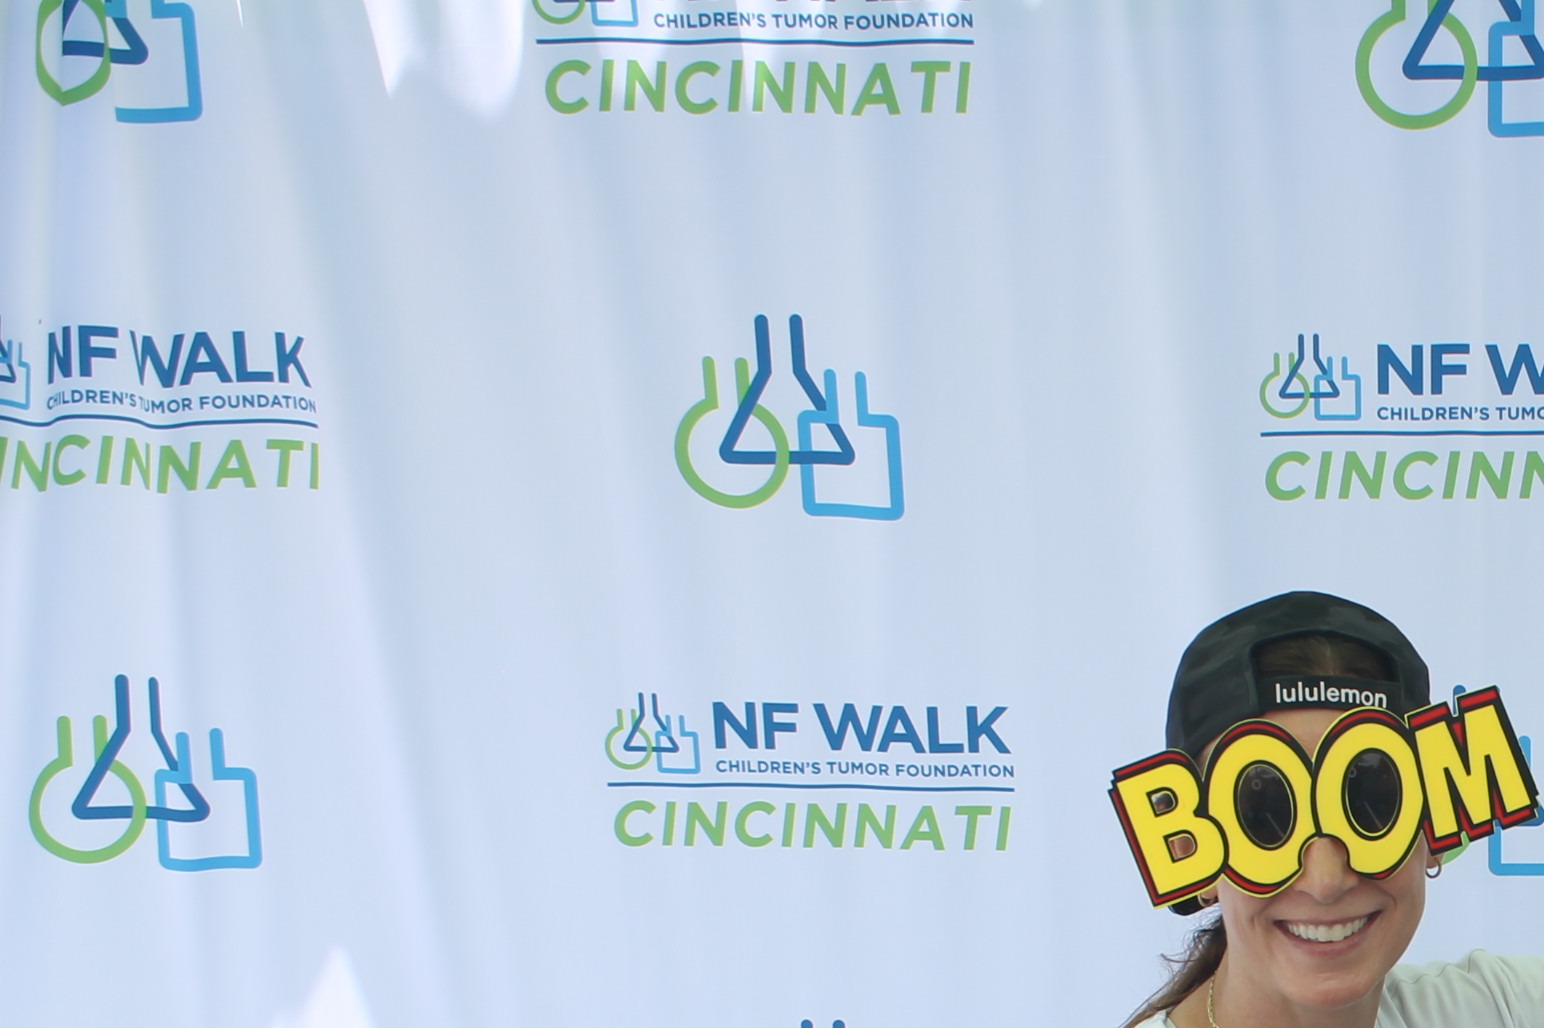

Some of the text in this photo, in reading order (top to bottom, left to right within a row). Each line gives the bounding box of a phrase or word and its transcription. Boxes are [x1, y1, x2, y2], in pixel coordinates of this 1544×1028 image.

[654, 12, 973, 29] CHILDREN'S TUMOR FOUNDATION
[545, 59, 970, 115] CINCINNATI
[48, 325, 310, 388] NF WALK
[1377, 343, 1470, 395] NF
[47, 389, 315, 413] CHILDREN'S TUMOR FOUNDATION
[1377, 407, 1489, 420] CHILDREN'S
[1275, 681, 1387, 708] lululemon
[712, 702, 1010, 753] NF WALK
[716, 760, 1014, 777] CHILDREN'S TUMOR FOUNDATION
[1110, 688, 1537, 906] BOOM
[614, 800, 1011, 850] CINCINNATI
